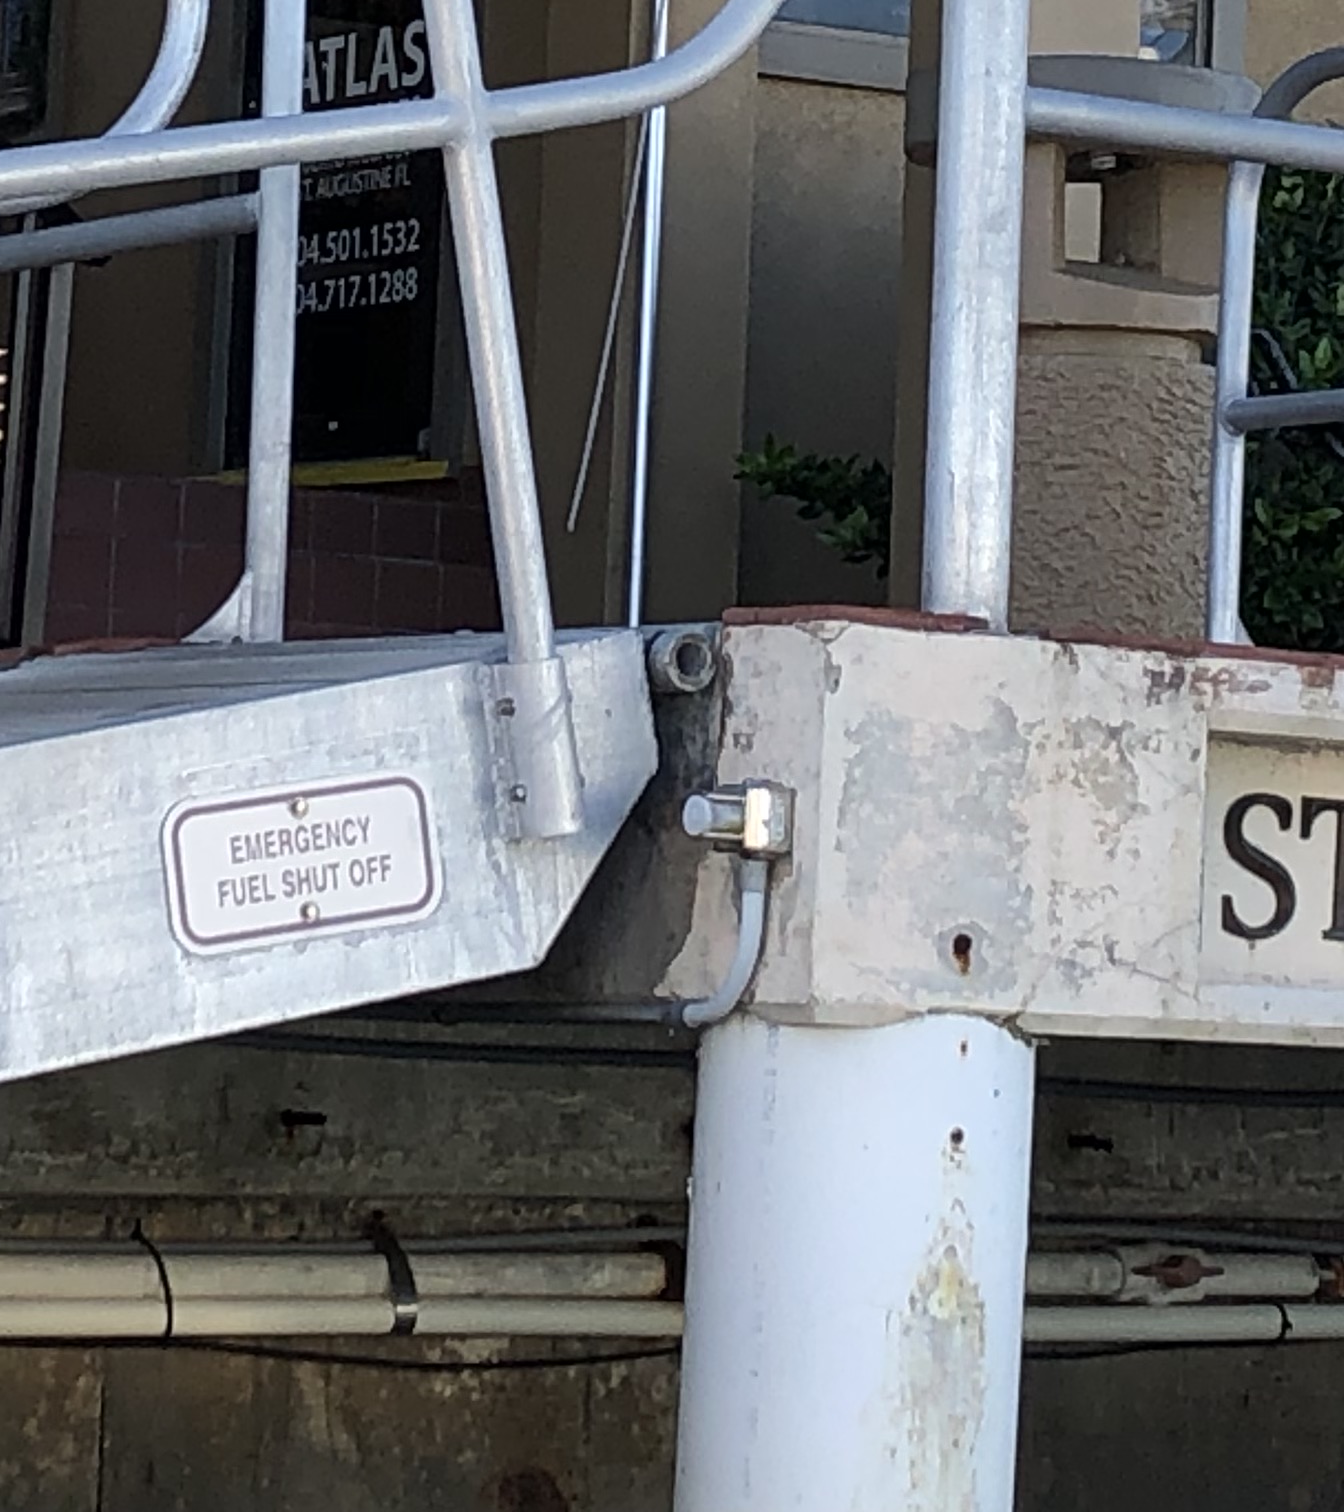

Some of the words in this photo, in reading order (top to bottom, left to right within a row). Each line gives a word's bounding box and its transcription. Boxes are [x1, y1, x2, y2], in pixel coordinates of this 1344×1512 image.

[229, 815, 371, 865] EMERGENCY
[217, 874, 277, 909] FUEL
[281, 861, 341, 898] SHUT
[348, 854, 393, 888] OFF
